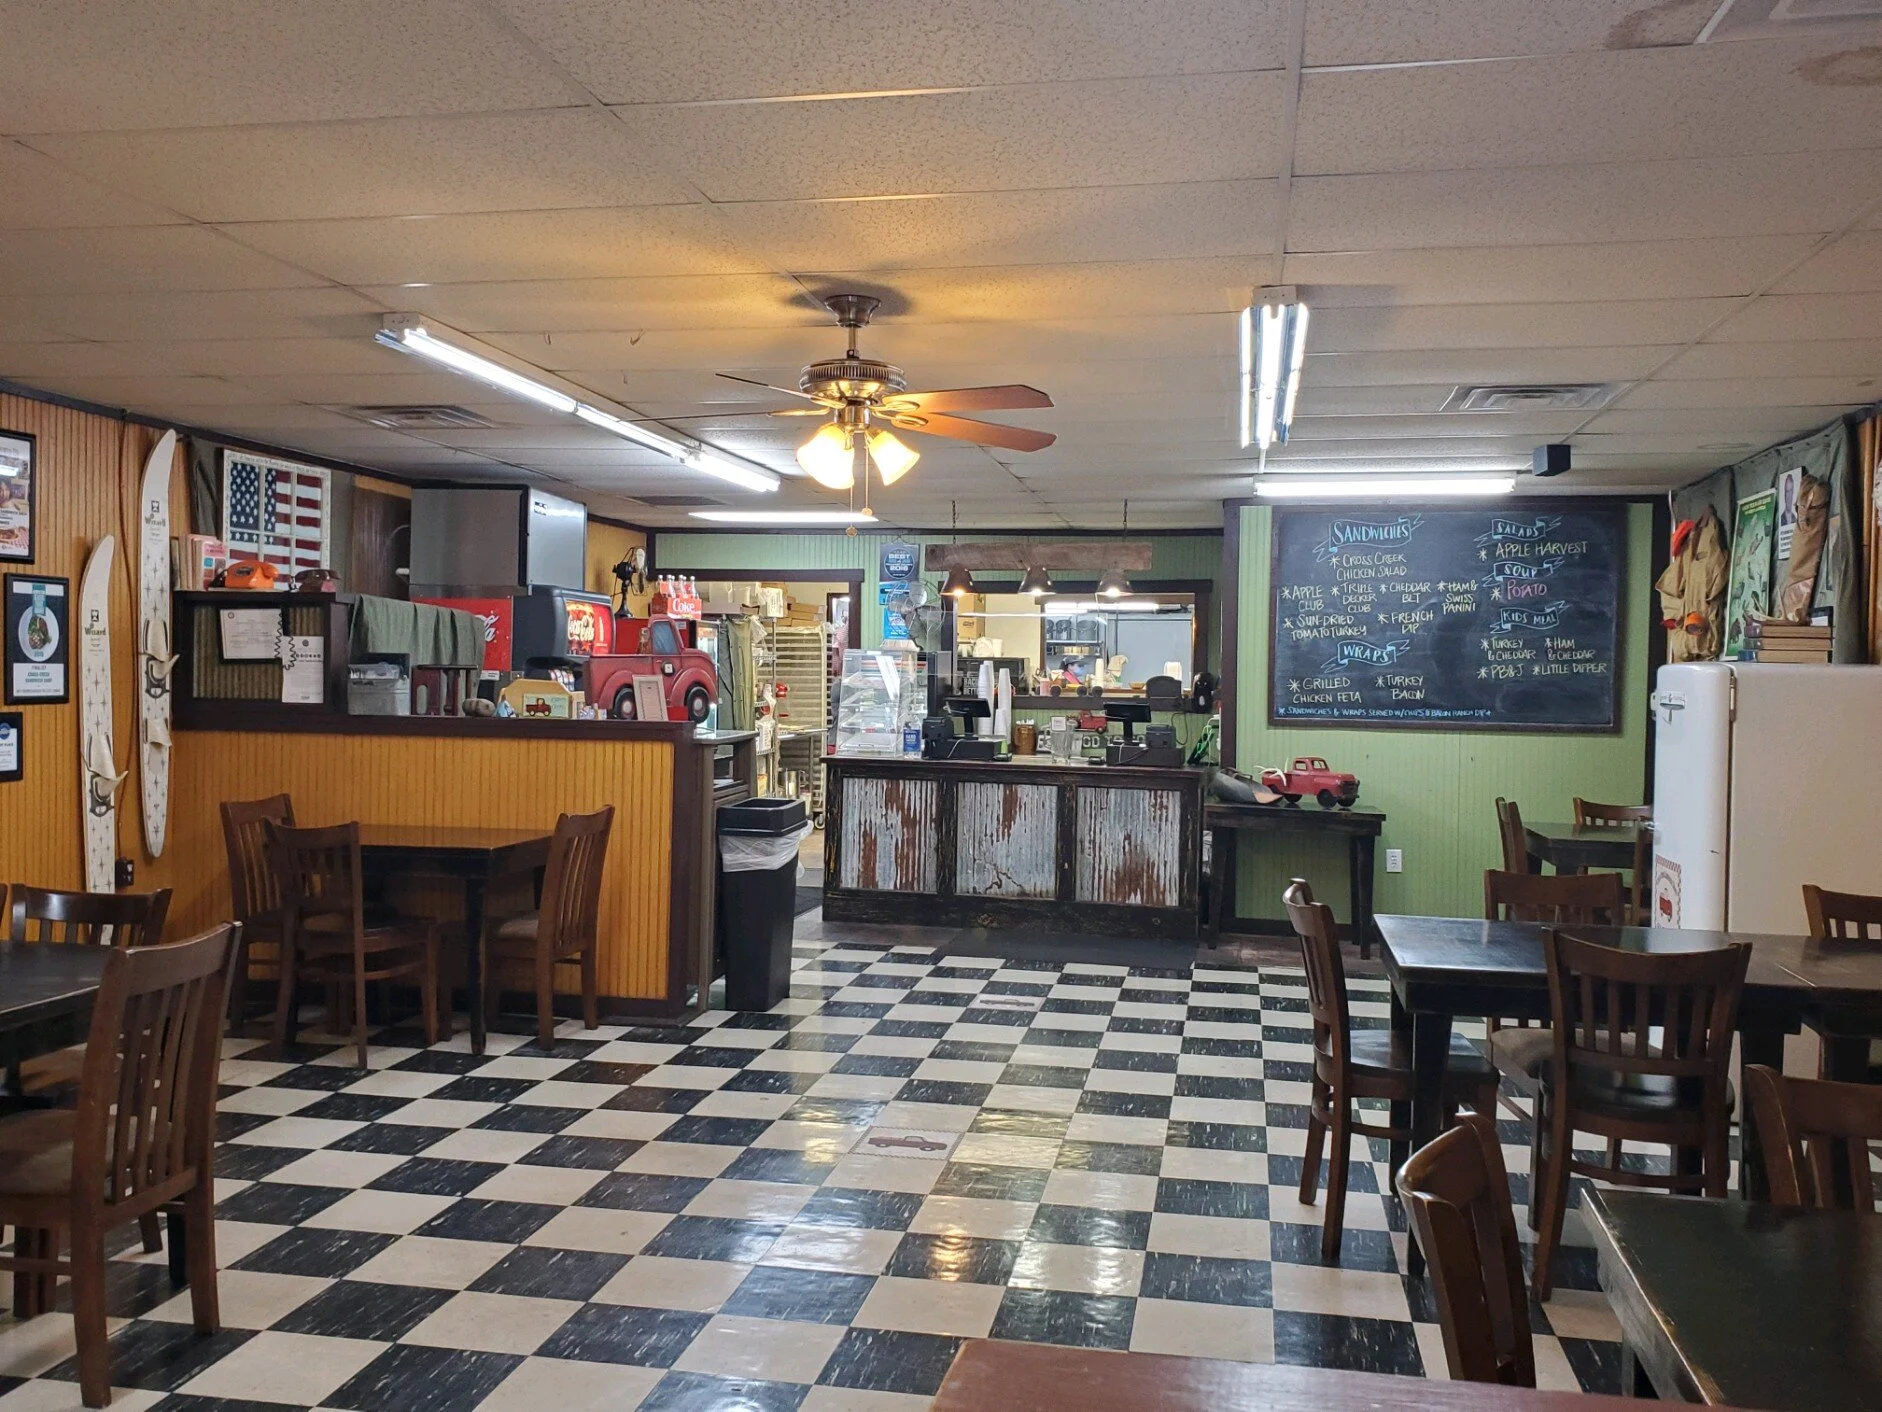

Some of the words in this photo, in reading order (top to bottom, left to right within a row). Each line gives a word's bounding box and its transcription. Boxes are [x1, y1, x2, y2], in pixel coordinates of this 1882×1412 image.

[1331, 520, 1410, 545] SANDWICHES
[1497, 522, 1539, 537] SALADS
[1495, 542, 1530, 559] APPLE
[1535, 541, 1588, 556] HARVEST
[1342, 553, 1371, 567] CROSS
[1373, 551, 1407, 565] CREEK
[1336, 567, 1375, 581] CHICKEN
[1377, 565, 1407, 577] SALAD
[1503, 563, 1539, 578] SOUP
[1291, 584, 1323, 600] APPLE
[1340, 581, 1373, 594] TRIPLE
[1389, 581, 1431, 593] CHEDDAR
[1507, 579, 1548, 600] POTATO
[1342, 593, 1378, 605] DECKER
[1402, 592, 1421, 603] BLT
[1445, 593, 1474, 603] SWISS
[672, 598, 695, 613] Coke
[1298, 599, 1325, 612] CLUB
[1347, 603, 1372, 614] CLUB
[1441, 602, 1476, 615] PANINI
[1297, 614, 1355, 627] SUN-DRIED
[1391, 610, 1434, 623] FRENCH
[1502, 611, 1527, 623] KIDS
[1533, 613, 1557, 625] MEAL
[1401, 623, 1420, 635] DIP
[1491, 636, 1524, 650] TURKEY
[1553, 637, 1575, 649] HAM
[1343, 644, 1390, 662] WRAPS
[1490, 663, 1523, 679] PB&J
[1541, 664, 1569, 676] LITTLE
[1573, 662, 1608, 673] DIPPER
[1302, 677, 1351, 690] GRILLED
[1386, 675, 1424, 687] TURKEY
[1292, 692, 1333, 704] CHICKEN
[1337, 691, 1362, 703] FETA
[1392, 688, 1426, 700] BACON
[1288, 706, 1331, 716] SANDWICHES
[1342, 708, 1367, 717] WRAPS
